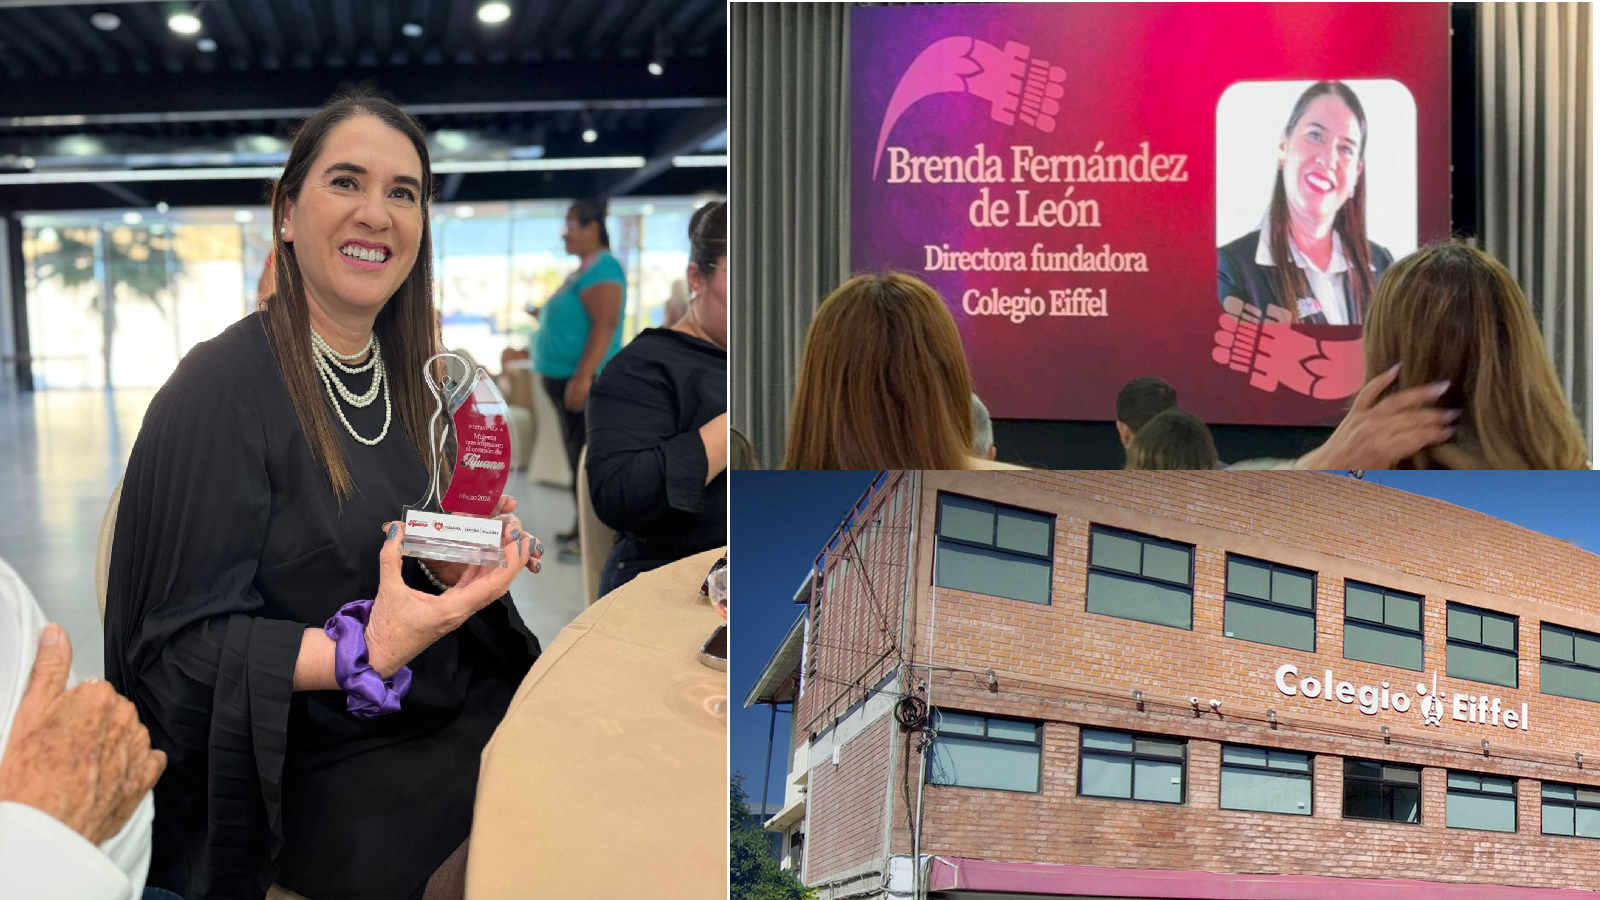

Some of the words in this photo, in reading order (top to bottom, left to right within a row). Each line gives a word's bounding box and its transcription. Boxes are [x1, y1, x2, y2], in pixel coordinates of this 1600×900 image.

[887, 143, 1005, 183] Brenda
[1010, 141, 1188, 183] Fernández
[969, 187, 1009, 227] de
[1015, 186, 1101, 227] León
[924, 244, 1027, 271] Directora
[1031, 243, 1149, 272] fundadora
[962, 288, 1045, 323] Colegio
[1049, 288, 1108, 316] Eiffel
[473, 433, 497, 441] Mujeres
[461, 453, 505, 470] Tijuana
[1275, 664, 1411, 715] Colegio
[1452, 693, 1529, 731] Eiffel
